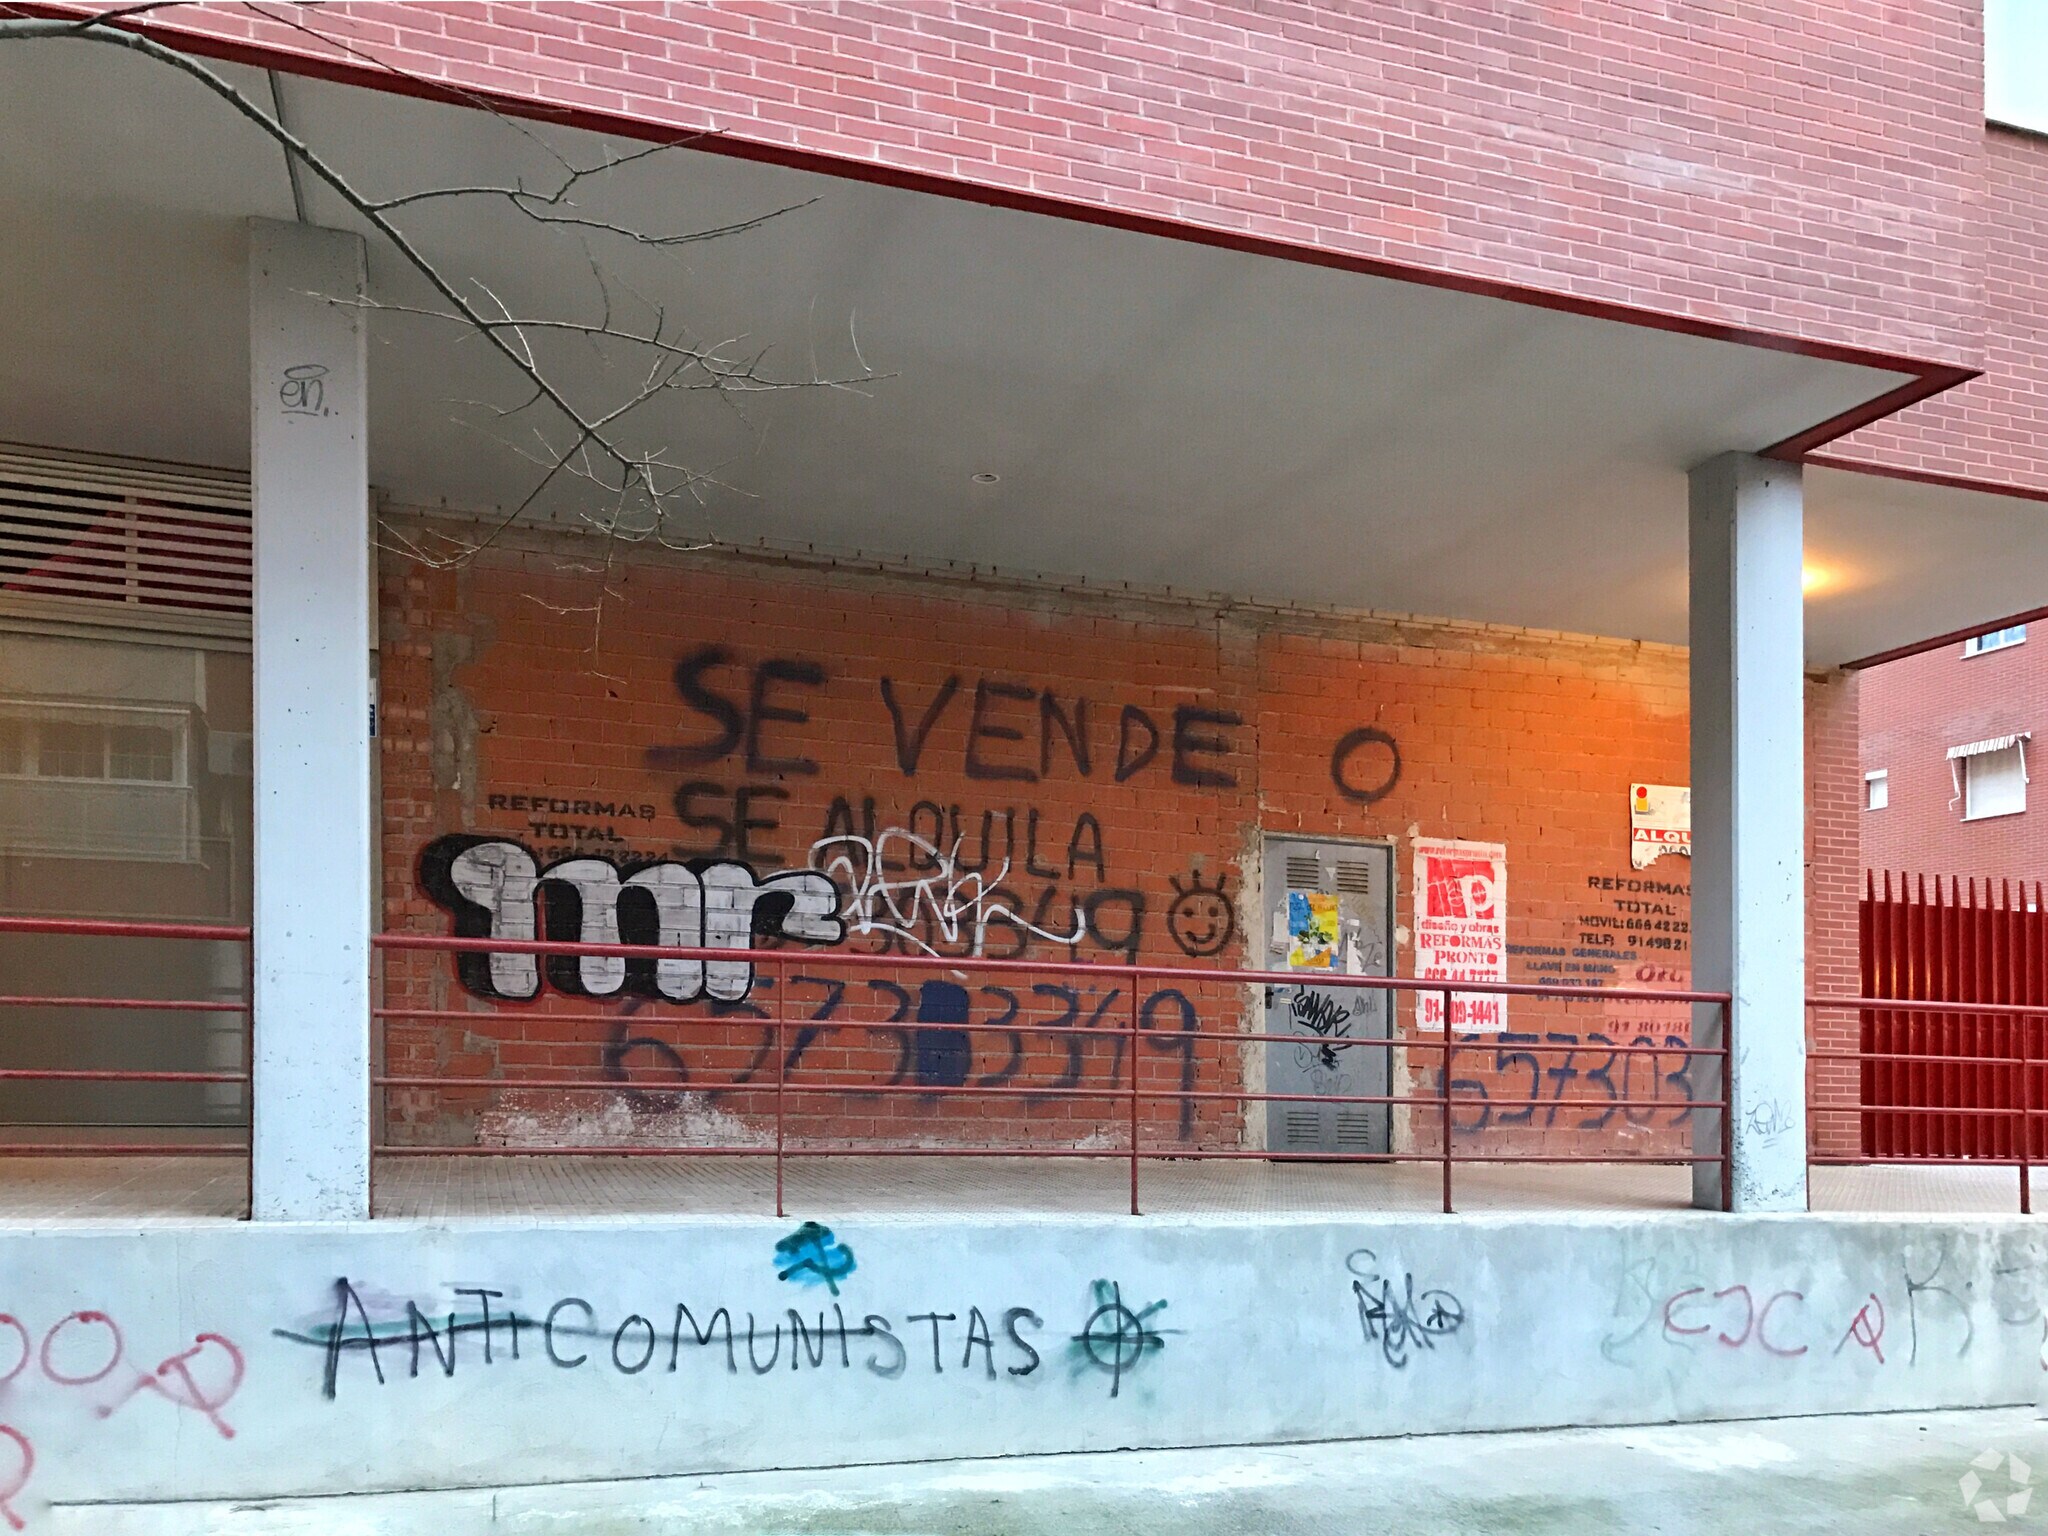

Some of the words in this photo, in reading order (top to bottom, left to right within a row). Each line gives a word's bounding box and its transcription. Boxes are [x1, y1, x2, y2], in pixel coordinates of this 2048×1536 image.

[643, 644, 825, 776] SE
[880, 673, 1243, 787] VENDE
[489, 794, 656, 820] REFORMAS
[528, 822, 625, 843] TOTAL
[672, 781, 789, 864] SE
[815, 796, 1106, 883] ALQUILA
[1614, 899, 1677, 917] TOTAL
[1461, 922, 1467, 934] y
[1469, 921, 1500, 934] obras
[1420, 933, 1502, 951] REFORMAS
[1434, 950, 1498, 965] PRONTO
[1424, 998, 1499, 1025] 91-09-1441
